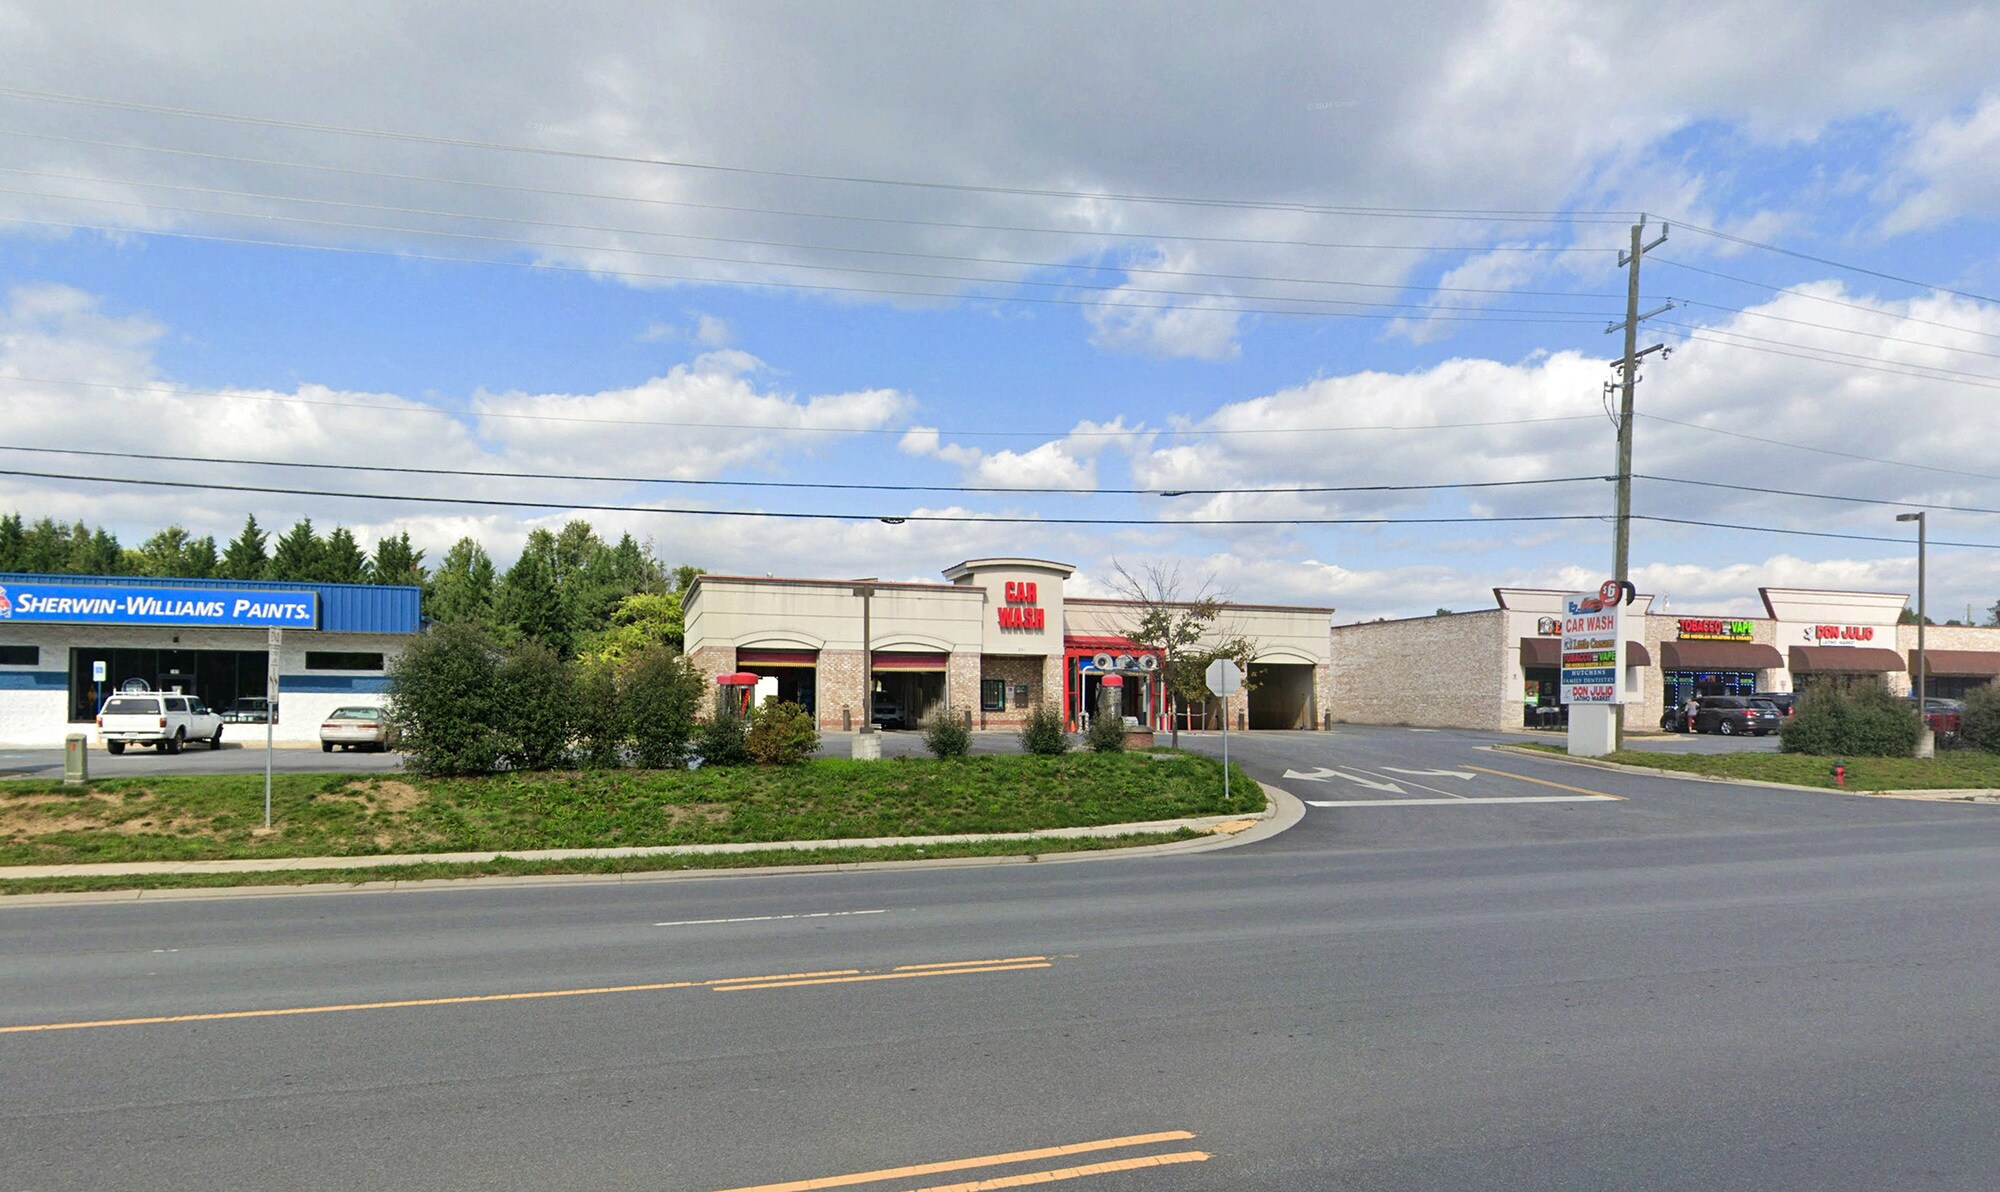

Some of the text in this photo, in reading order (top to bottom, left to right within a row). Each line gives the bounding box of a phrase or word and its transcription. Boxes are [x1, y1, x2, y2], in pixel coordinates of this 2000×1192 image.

[1005, 581, 1037, 603] CAR
[15, 593, 224, 617] SHERWIN-WILLIAMS
[997, 607, 1045, 629] WASH
[1565, 617, 1584, 633] CAR
[1586, 615, 1614, 631] WASH
[1680, 619, 1722, 633] TOBACCO
[1731, 621, 1755, 634] VAPE
[1815, 625, 1874, 641] DON JULIO
[1598, 651, 1616, 661] VAPE
[1572, 686, 1613, 696] DON JULIO
